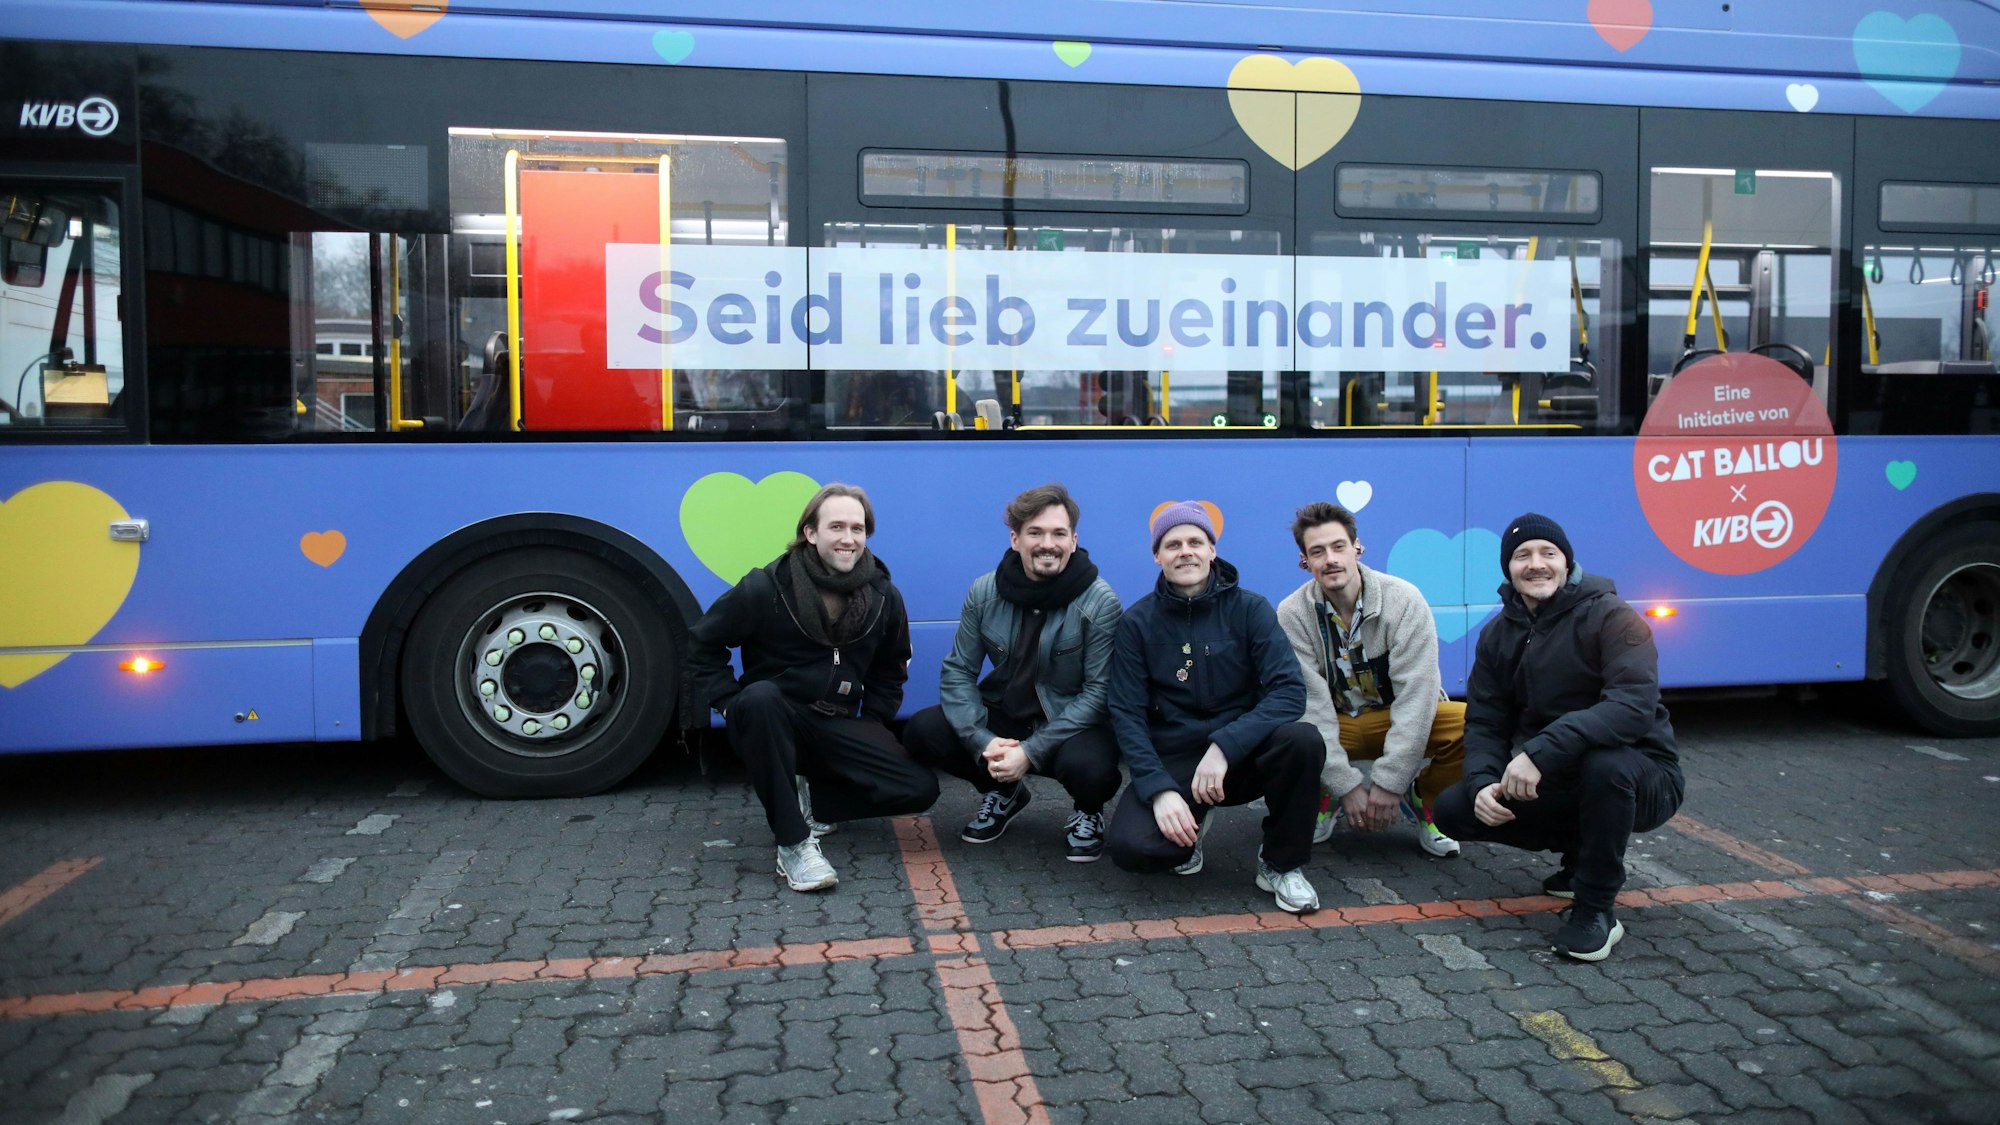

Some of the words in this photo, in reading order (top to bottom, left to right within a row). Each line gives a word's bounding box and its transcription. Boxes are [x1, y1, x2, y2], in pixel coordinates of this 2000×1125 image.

[20, 103, 76, 127] KVB
[637, 270, 842, 345] Seid
[879, 272, 1036, 346] lieb
[1066, 277, 1547, 350] zueinander.
[1714, 385, 1750, 401] Eine
[1678, 408, 1755, 429] Initiative
[1759, 407, 1789, 421] von
[1648, 450, 1705, 482] CAT
[1714, 438, 1823, 476] BALLOU
[1693, 515, 1749, 547] KVB
